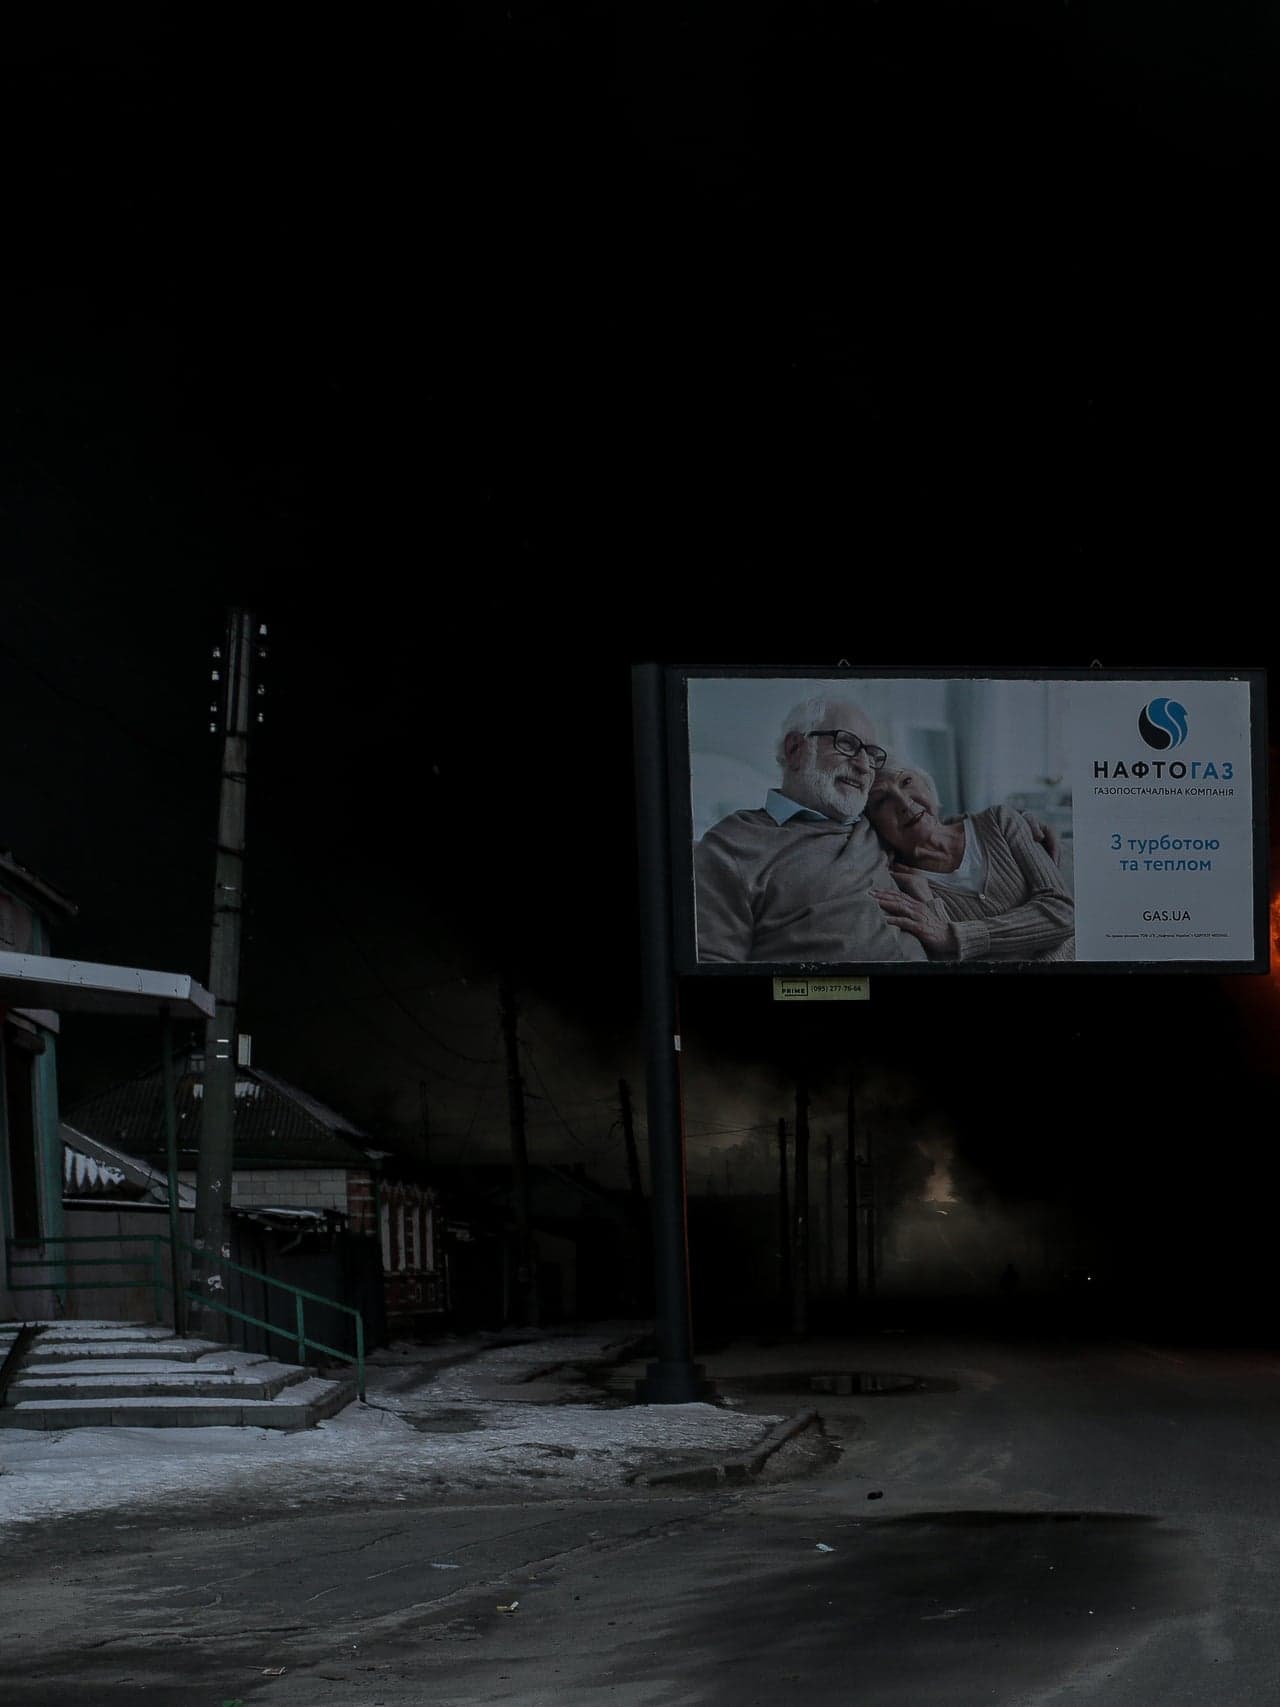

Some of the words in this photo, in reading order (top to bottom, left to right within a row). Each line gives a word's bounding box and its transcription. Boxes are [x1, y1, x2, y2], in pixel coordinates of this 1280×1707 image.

[1094, 761, 1233, 779] НАФТОГАЗ
[1094, 787, 1182, 796] ГАЗОПОСТАЧАЛЬНА
[1185, 788, 1234, 797] КОМПАНІЯ
[1111, 834, 1122, 850] З
[1128, 834, 1220, 854] турботою
[1120, 860, 1138, 871] та
[1143, 860, 1212, 871] теплом
[1142, 910, 1191, 921] GAS.UA
